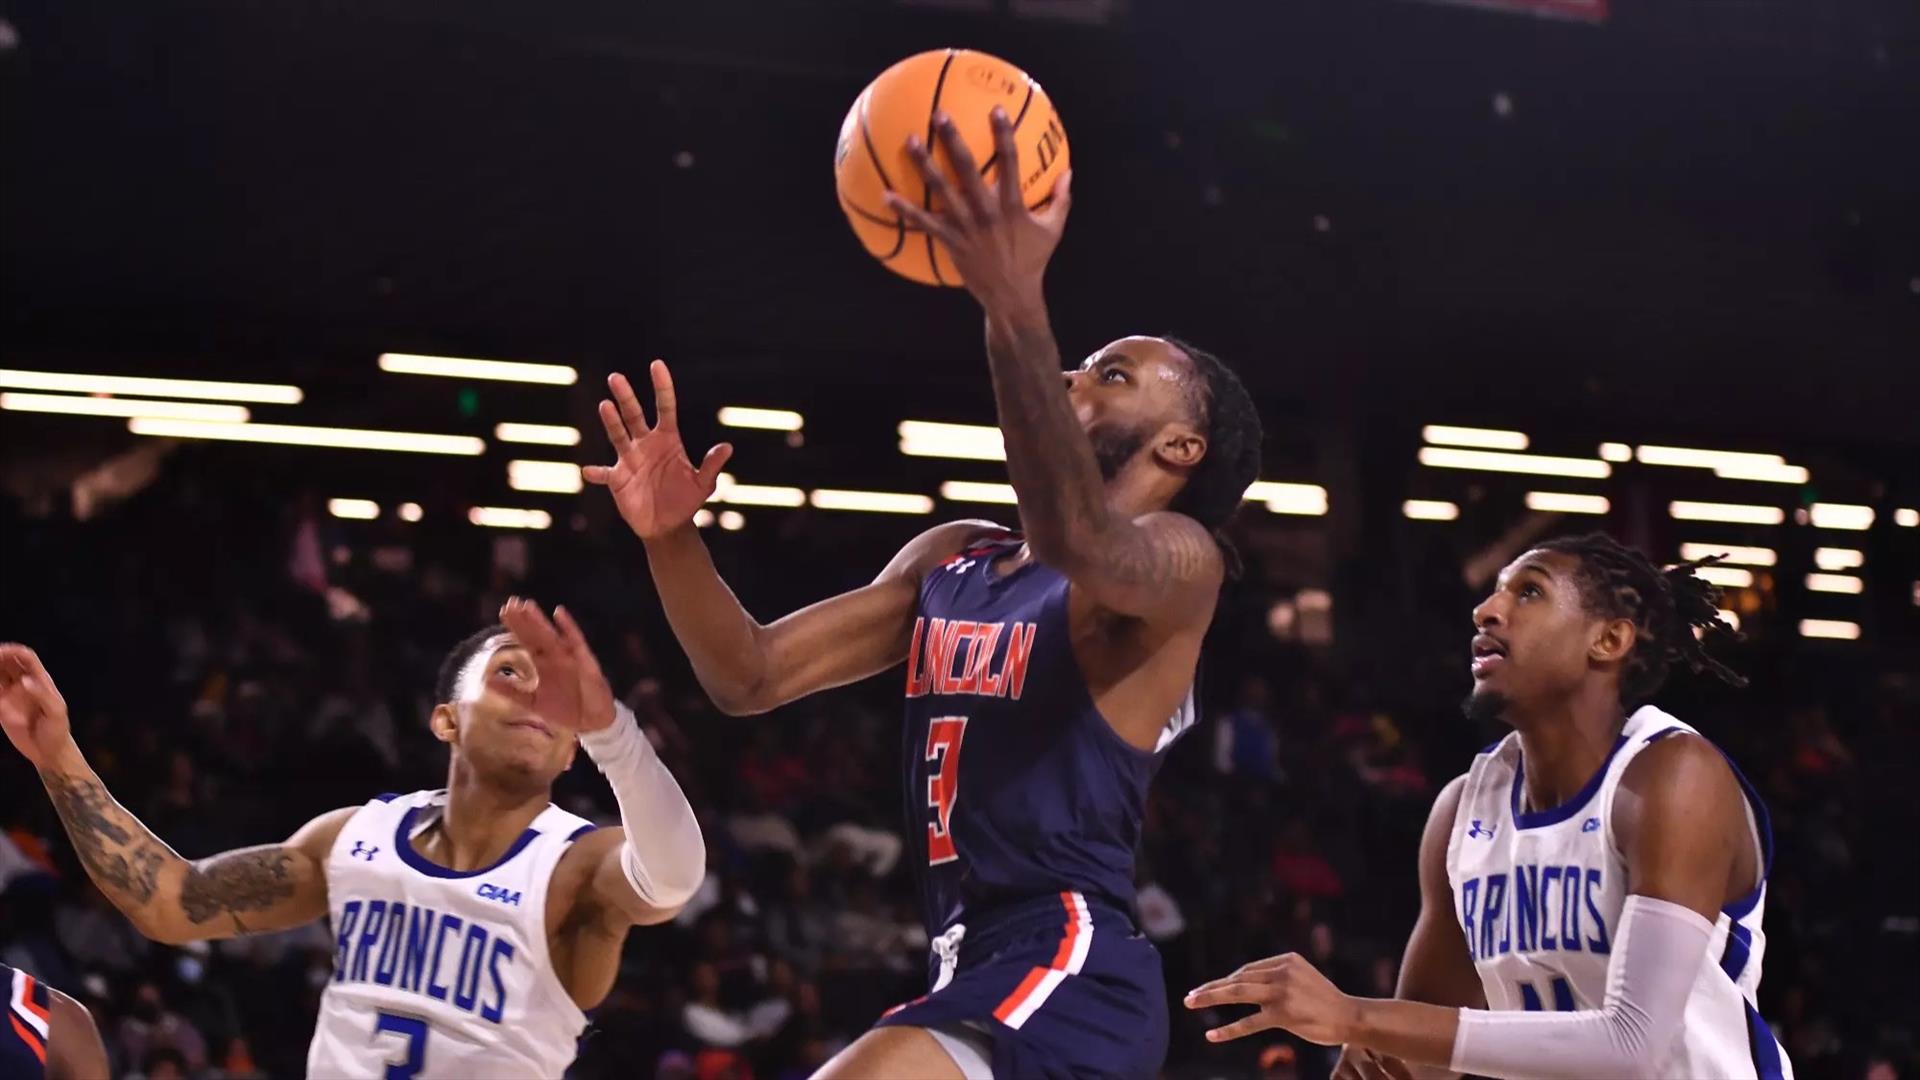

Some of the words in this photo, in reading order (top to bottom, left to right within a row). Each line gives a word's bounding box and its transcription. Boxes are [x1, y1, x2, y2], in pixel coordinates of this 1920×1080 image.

[905, 617, 1036, 700] LINCOLN
[925, 715, 968, 866] 3
[477, 883, 521, 906] CIAA
[335, 900, 514, 1025] BRONCOS
